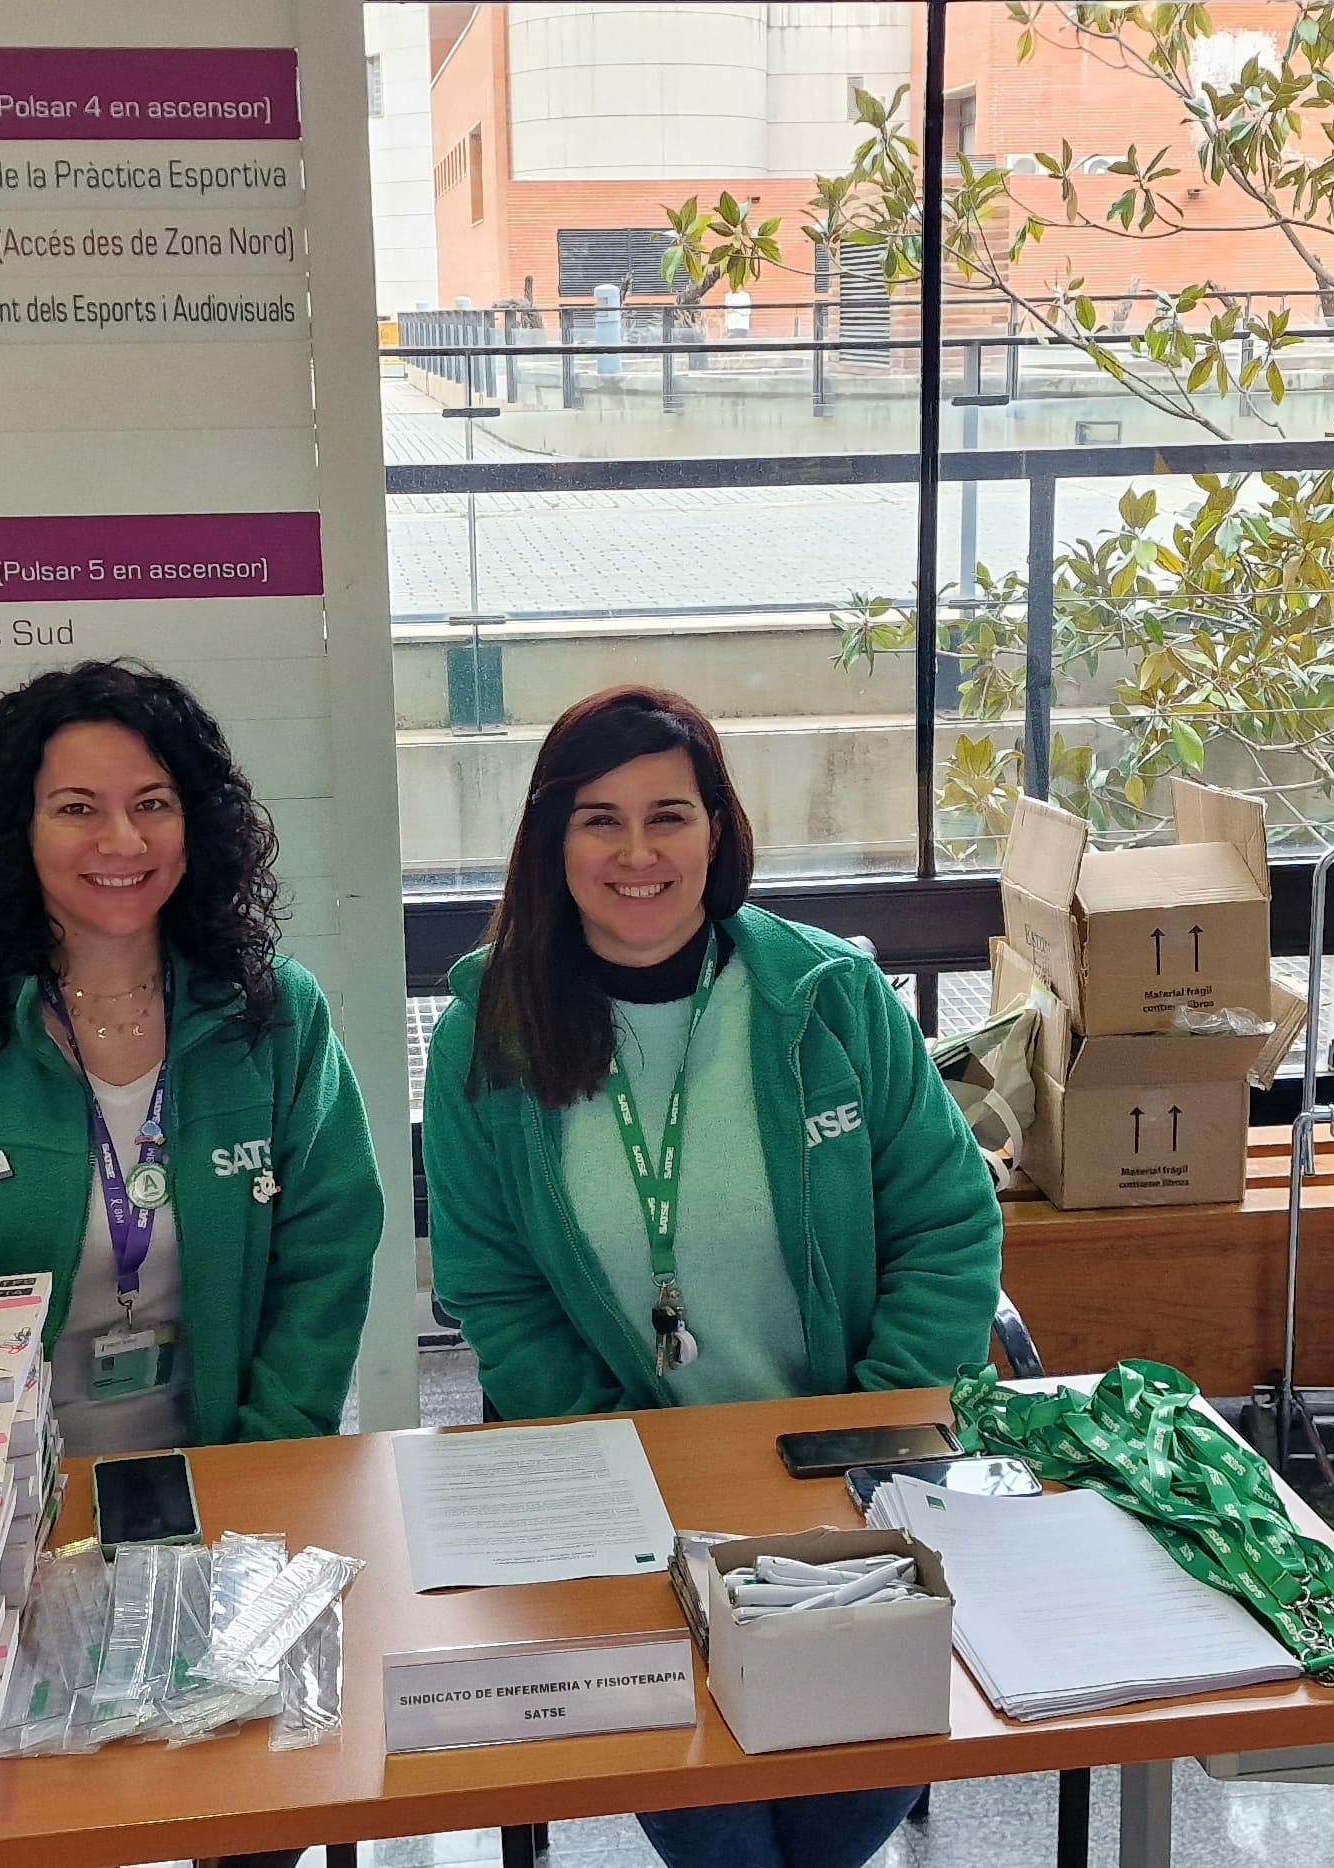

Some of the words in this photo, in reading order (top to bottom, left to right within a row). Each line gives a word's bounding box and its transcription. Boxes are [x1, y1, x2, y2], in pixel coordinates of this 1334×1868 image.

[84, 96, 101, 118] 4
[110, 99, 140, 118] en
[148, 96, 271, 123] ascensor)
[28, 160, 47, 188] la
[56, 160, 161, 188] Pràctica
[170, 160, 287, 195] Esportiva
[83, 228, 123, 256] des
[131, 228, 158, 256] de
[165, 228, 222, 256] Zona
[229, 227, 294, 262] Nord)
[28, 295, 67, 322] dels
[74, 295, 156, 328] Esports
[173, 294, 295, 323] Audiovisuals
[89, 560, 105, 580] 5
[113, 563, 142, 580] en
[149, 557, 269, 582] ascensor)
[13, 619, 74, 646] Sud
[617, 1093, 633, 1126] SATSE
[101, 1142, 116, 1179] SATSE
[632, 1145, 648, 1178] SATSE
[663, 1146, 675, 1180] SATSE
[658, 1201, 670, 1236] SATSE
[399, 1689, 472, 1707] SINDICATO
[475, 1687, 493, 1699] DE
[496, 1679, 581, 1699] ENFERMERIA
[583, 1679, 593, 1690] Y
[596, 1670, 686, 1688] FISIOTERAPIA
[523, 1706, 567, 1721] SATSE
